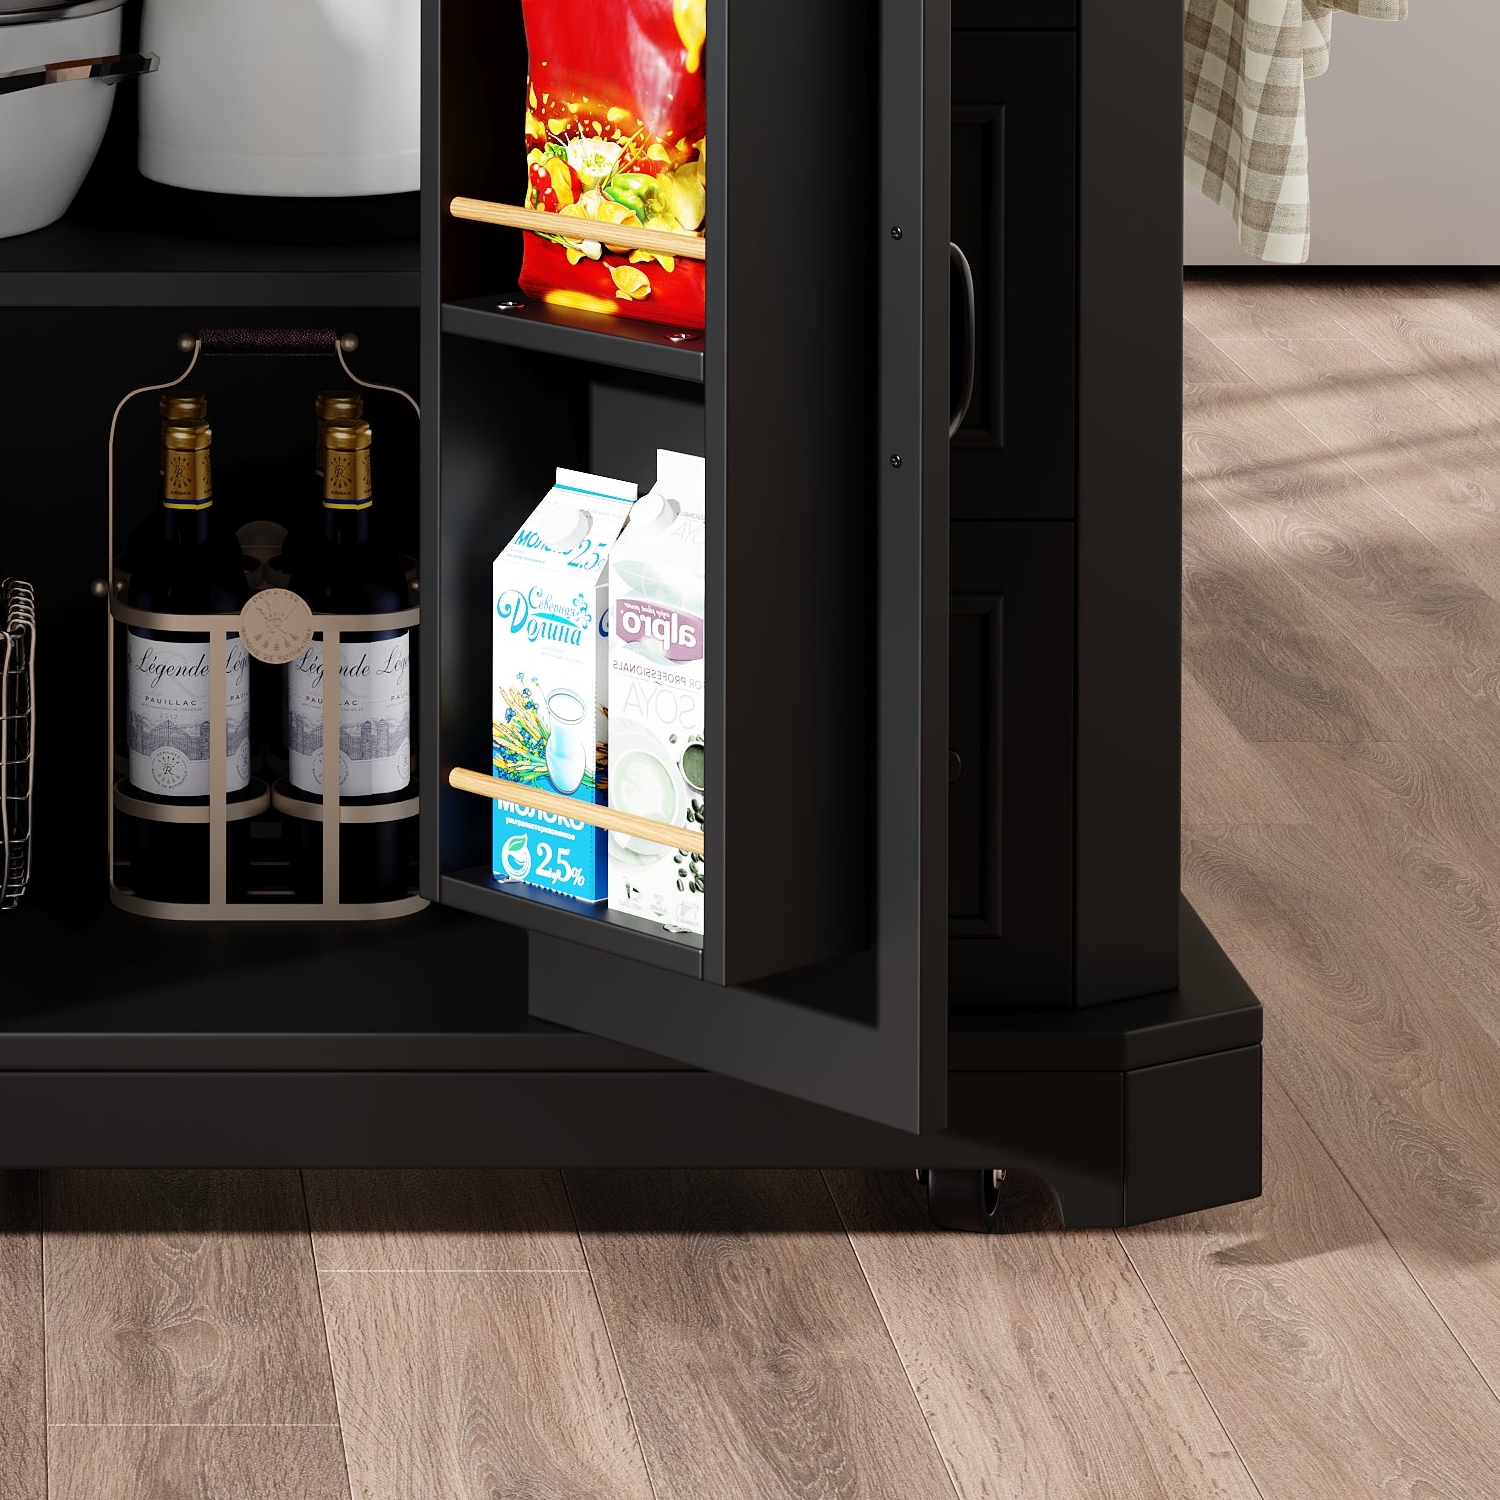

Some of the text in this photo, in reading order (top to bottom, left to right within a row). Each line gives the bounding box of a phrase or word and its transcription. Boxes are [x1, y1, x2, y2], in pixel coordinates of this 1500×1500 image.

[135, 647, 211, 688] Légende
[295, 647, 371, 688] Légnde
[145, 696, 197, 706] PAUILLAC
[535, 842, 585, 887] 2,5%
